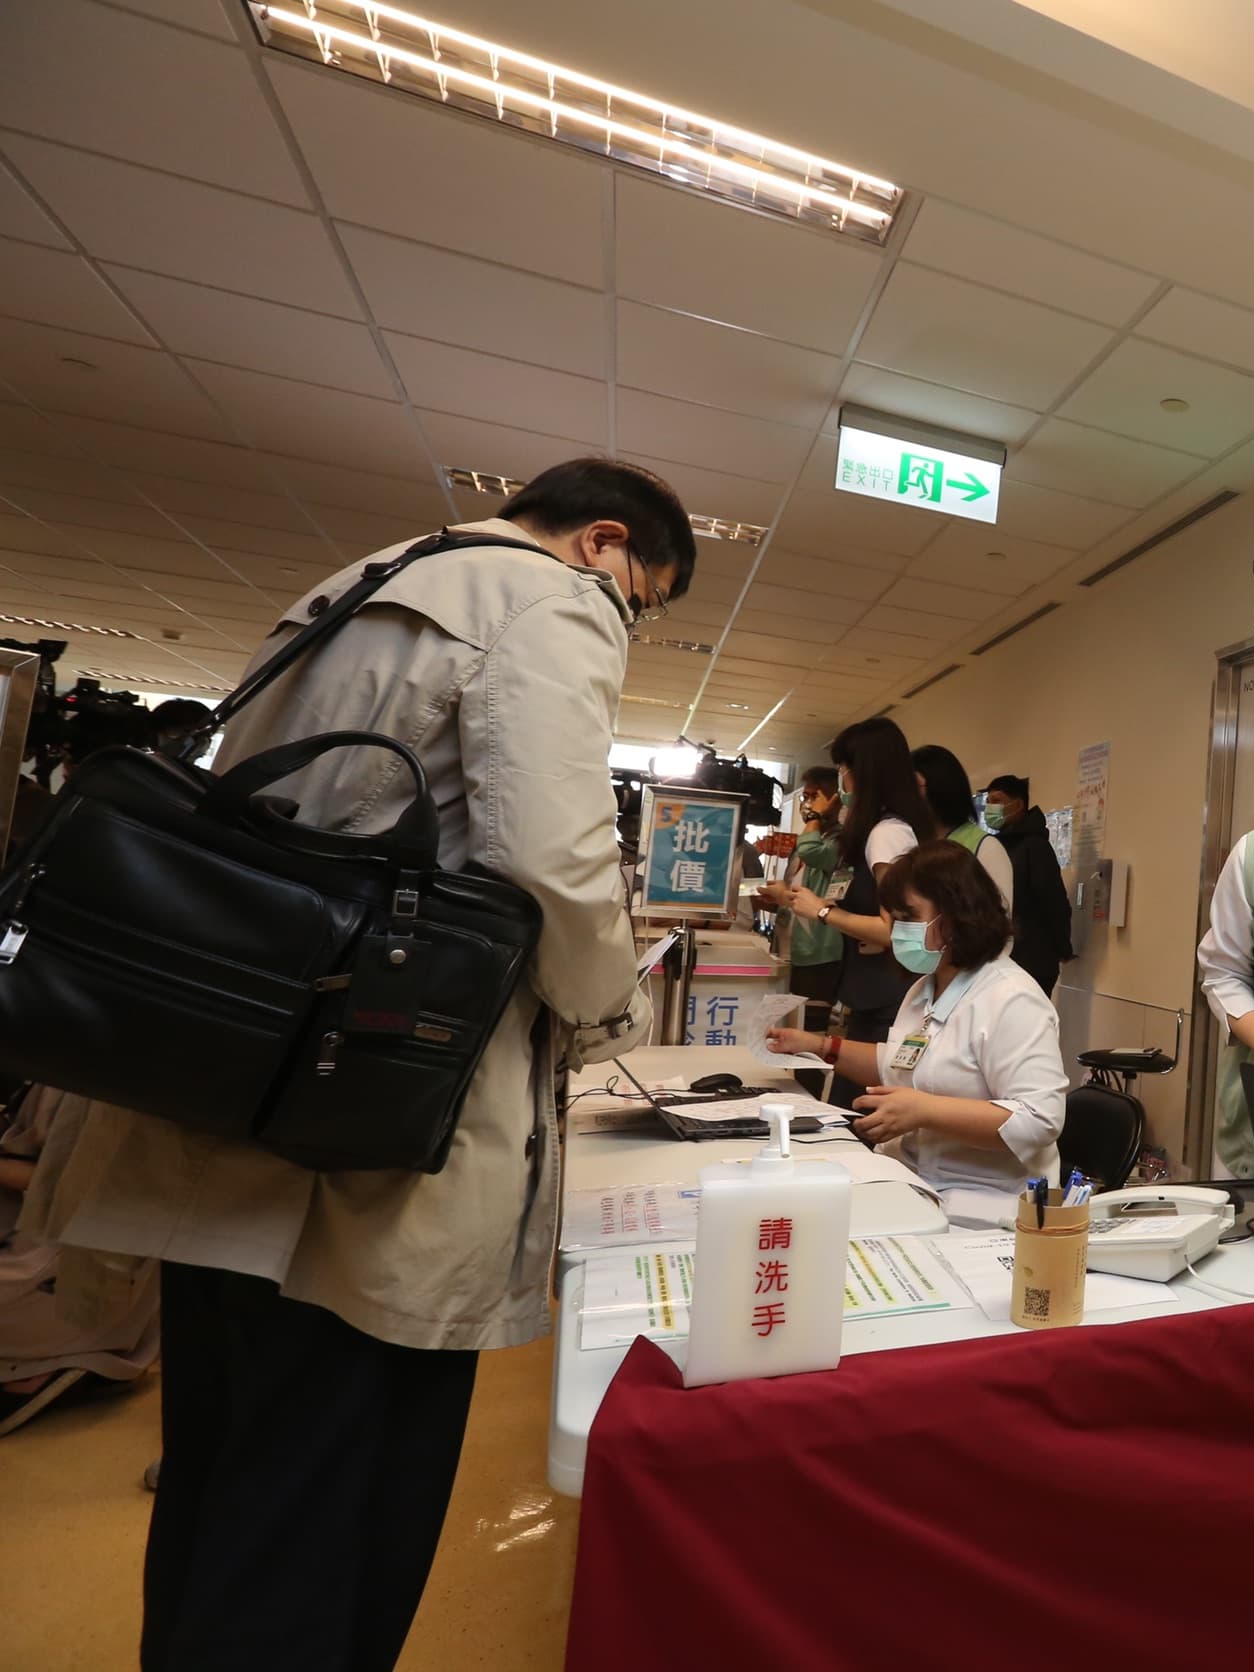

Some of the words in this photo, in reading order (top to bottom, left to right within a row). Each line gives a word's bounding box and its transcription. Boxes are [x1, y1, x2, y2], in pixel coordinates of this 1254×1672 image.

[842, 458, 894, 481] 緊急出口
[842, 471, 891, 492] EXIT
[660, 806, 673, 823] 5
[670, 820, 710, 893] 批價
[751, 1217, 794, 1338] 請洗手
